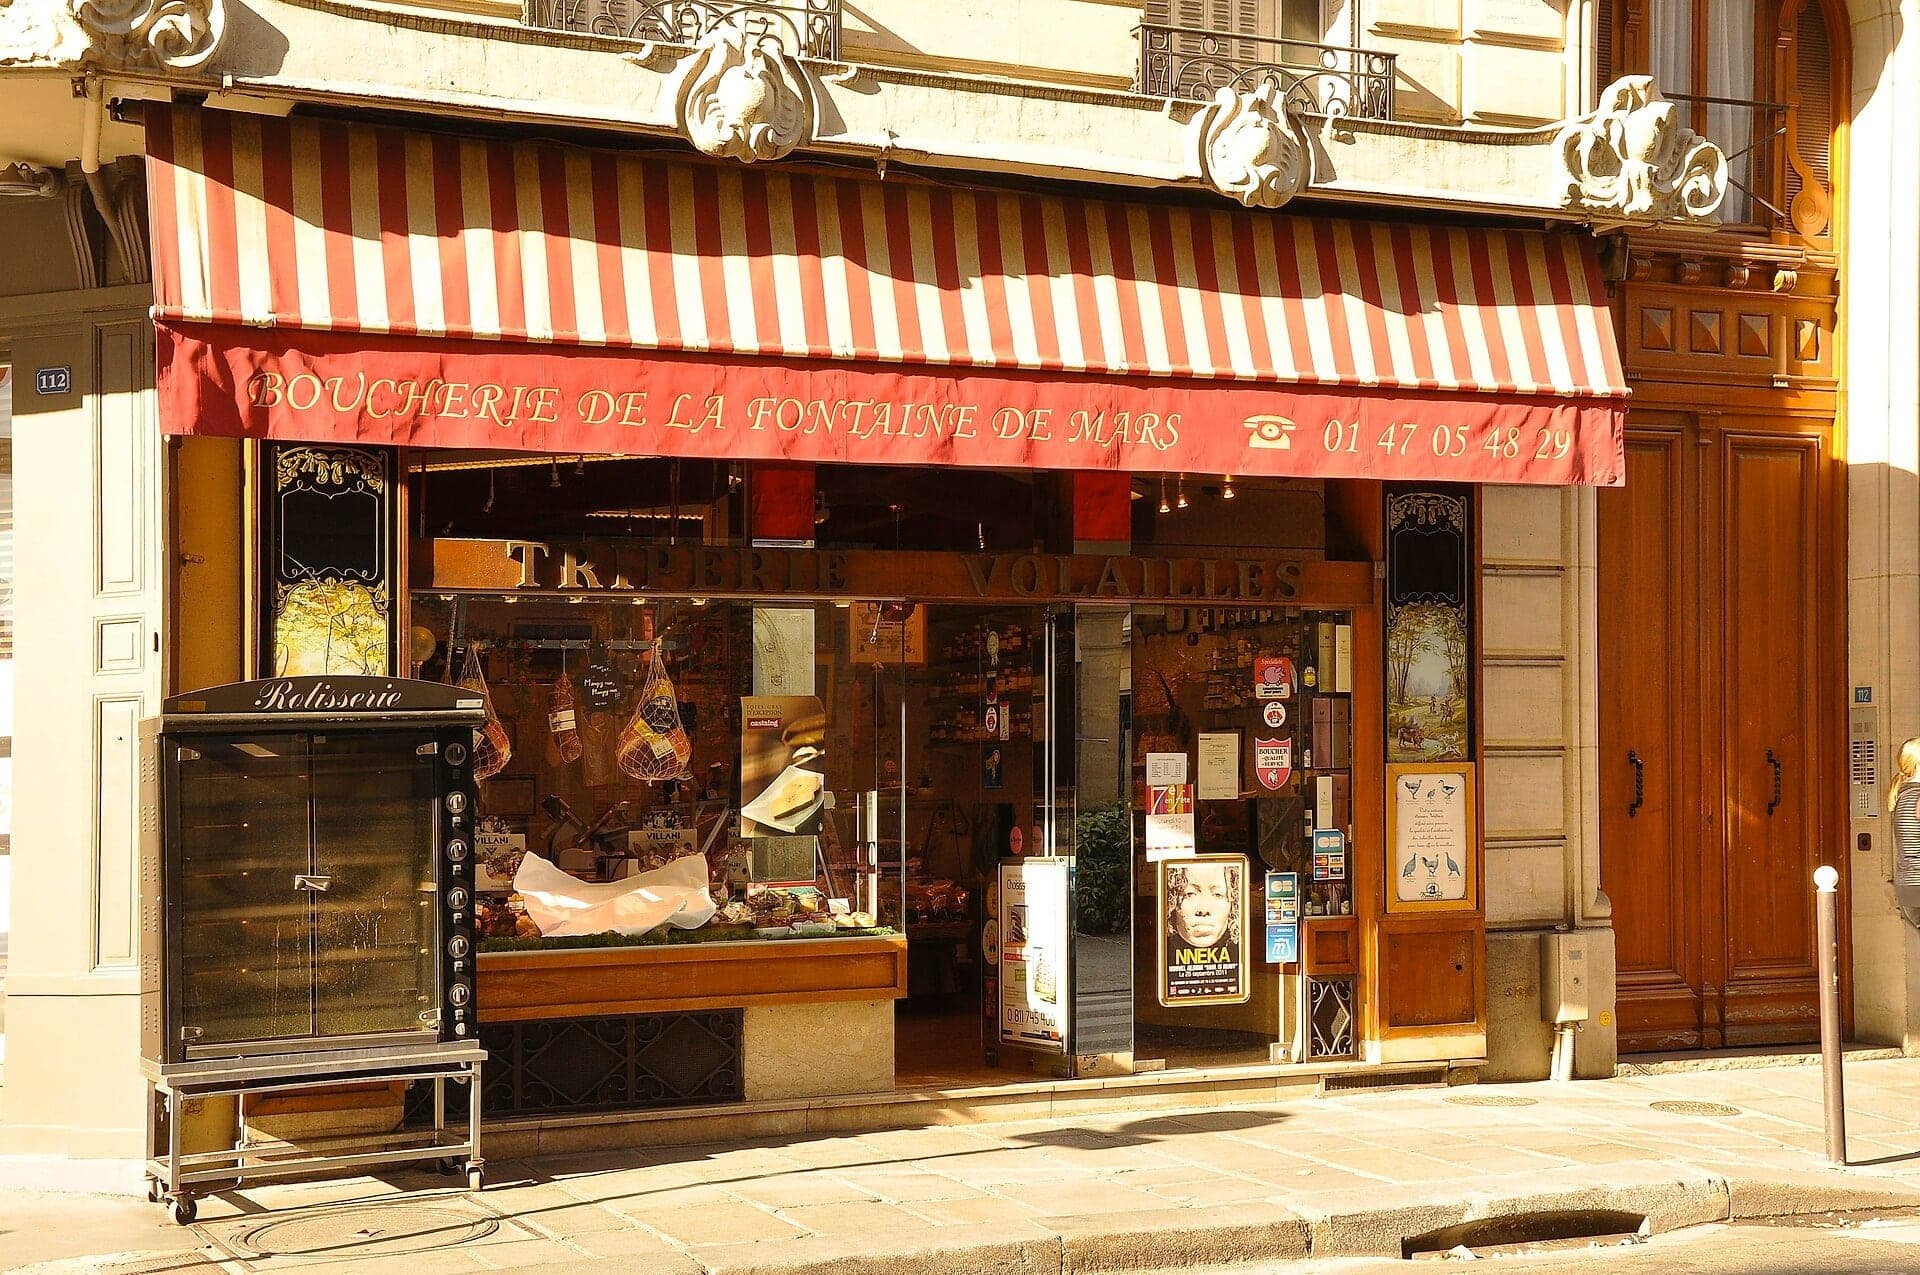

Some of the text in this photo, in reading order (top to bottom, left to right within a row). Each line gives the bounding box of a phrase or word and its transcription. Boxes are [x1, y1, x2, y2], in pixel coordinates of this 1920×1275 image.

[40, 373, 66, 389] 112
[249, 371, 1182, 451] BOUCHERIE DE LA FONTAINE DE MARS
[1322, 418, 1572, 460] 01 47 05 48 29
[506, 540, 850, 592] TRIPERIE
[960, 554, 1304, 601] VOLAILLES
[1857, 689, 1869, 701] 112
[475, 836, 509, 845] VILLANI
[647, 831, 680, 841] VILLANI
[1175, 947, 1231, 965] NNEKA
